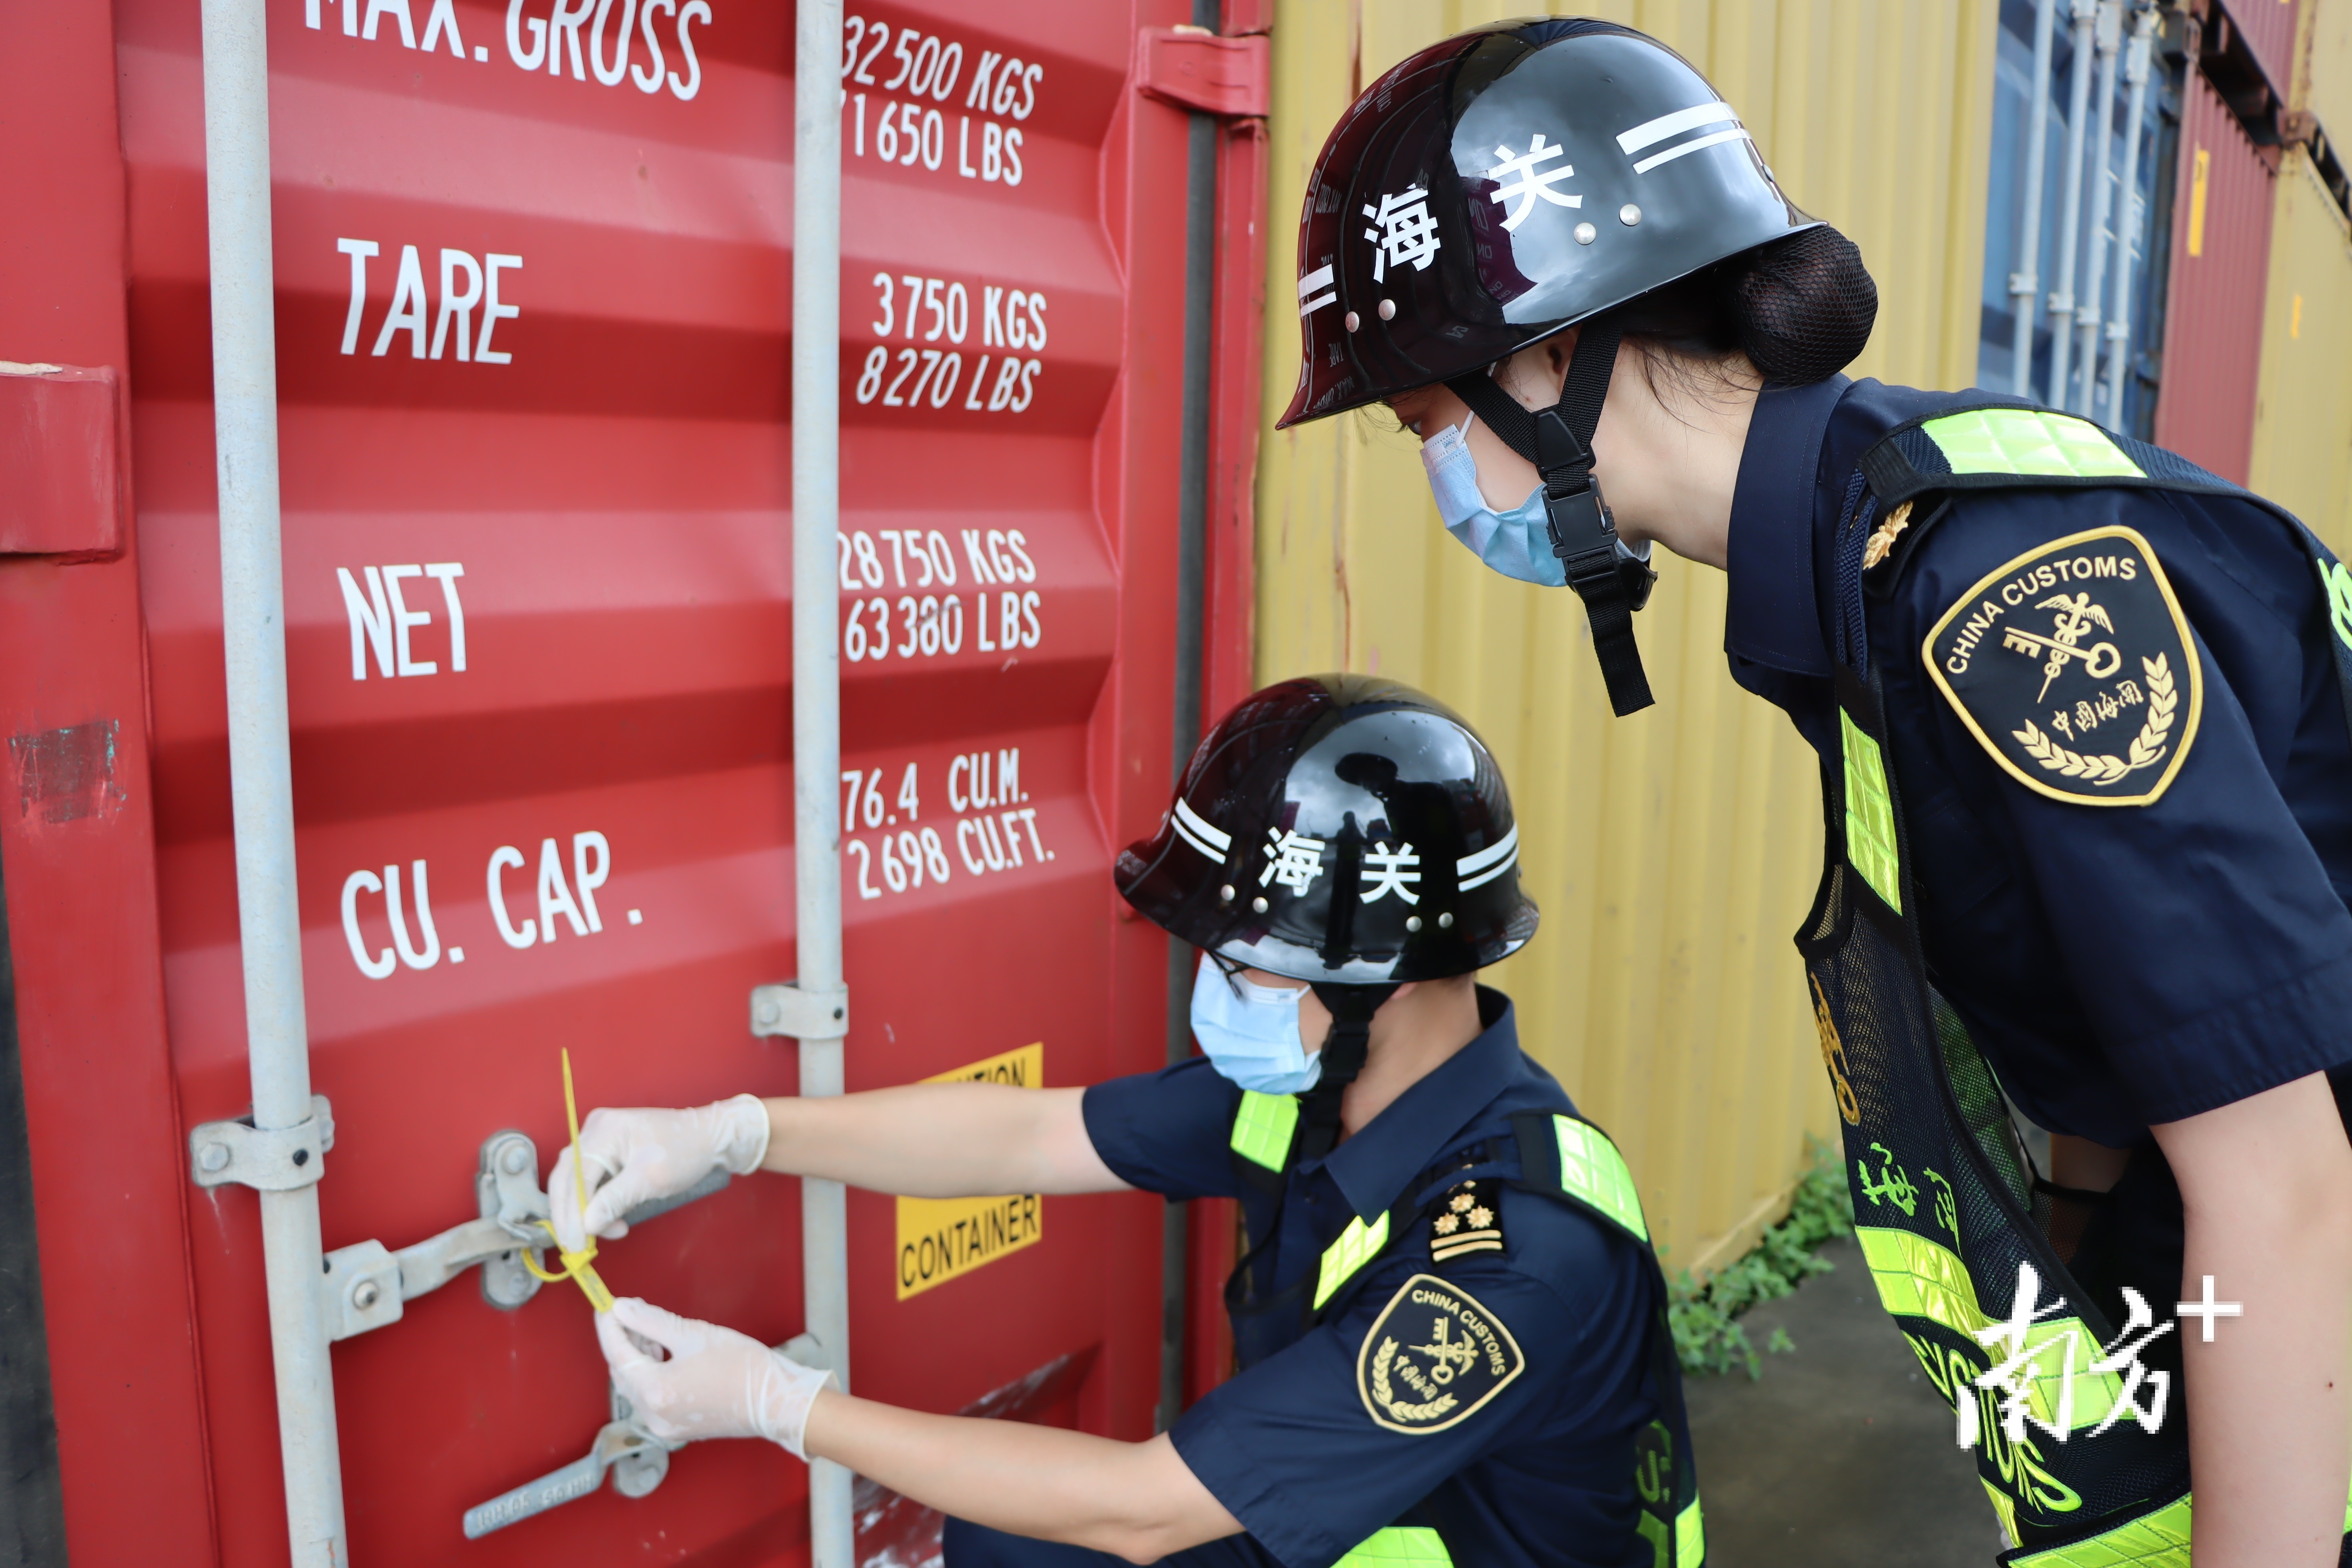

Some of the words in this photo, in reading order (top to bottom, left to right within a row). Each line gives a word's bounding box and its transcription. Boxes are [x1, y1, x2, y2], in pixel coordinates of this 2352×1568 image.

[506, 0, 712, 101] GROSS
[966, 50, 1043, 121] KGS
[840, 88, 945, 172] 1650
[958, 116, 1024, 187] LBS
[1362, 133, 1583, 284] 海关
[337, 237, 524, 365] TARE
[983, 285, 1048, 352] KGS
[965, 355, 1042, 413] LBS
[960, 528, 1037, 585] KGS
[336, 562, 467, 681] NET
[978, 590, 1041, 652] LBS
[1946, 600, 2005, 674] CHINA
[2001, 555, 2137, 607] CUSTOMS
[841, 762, 919, 833] 76.4
[341, 859, 466, 980] CU.
[486, 830, 644, 950] CAP.
[1258, 826, 1422, 906] 海关
[901, 1194, 1038, 1288] CONTAINER
[1411, 1289, 1461, 1315] CHINA
[1459, 1309, 1506, 1376] CUSTOMS
